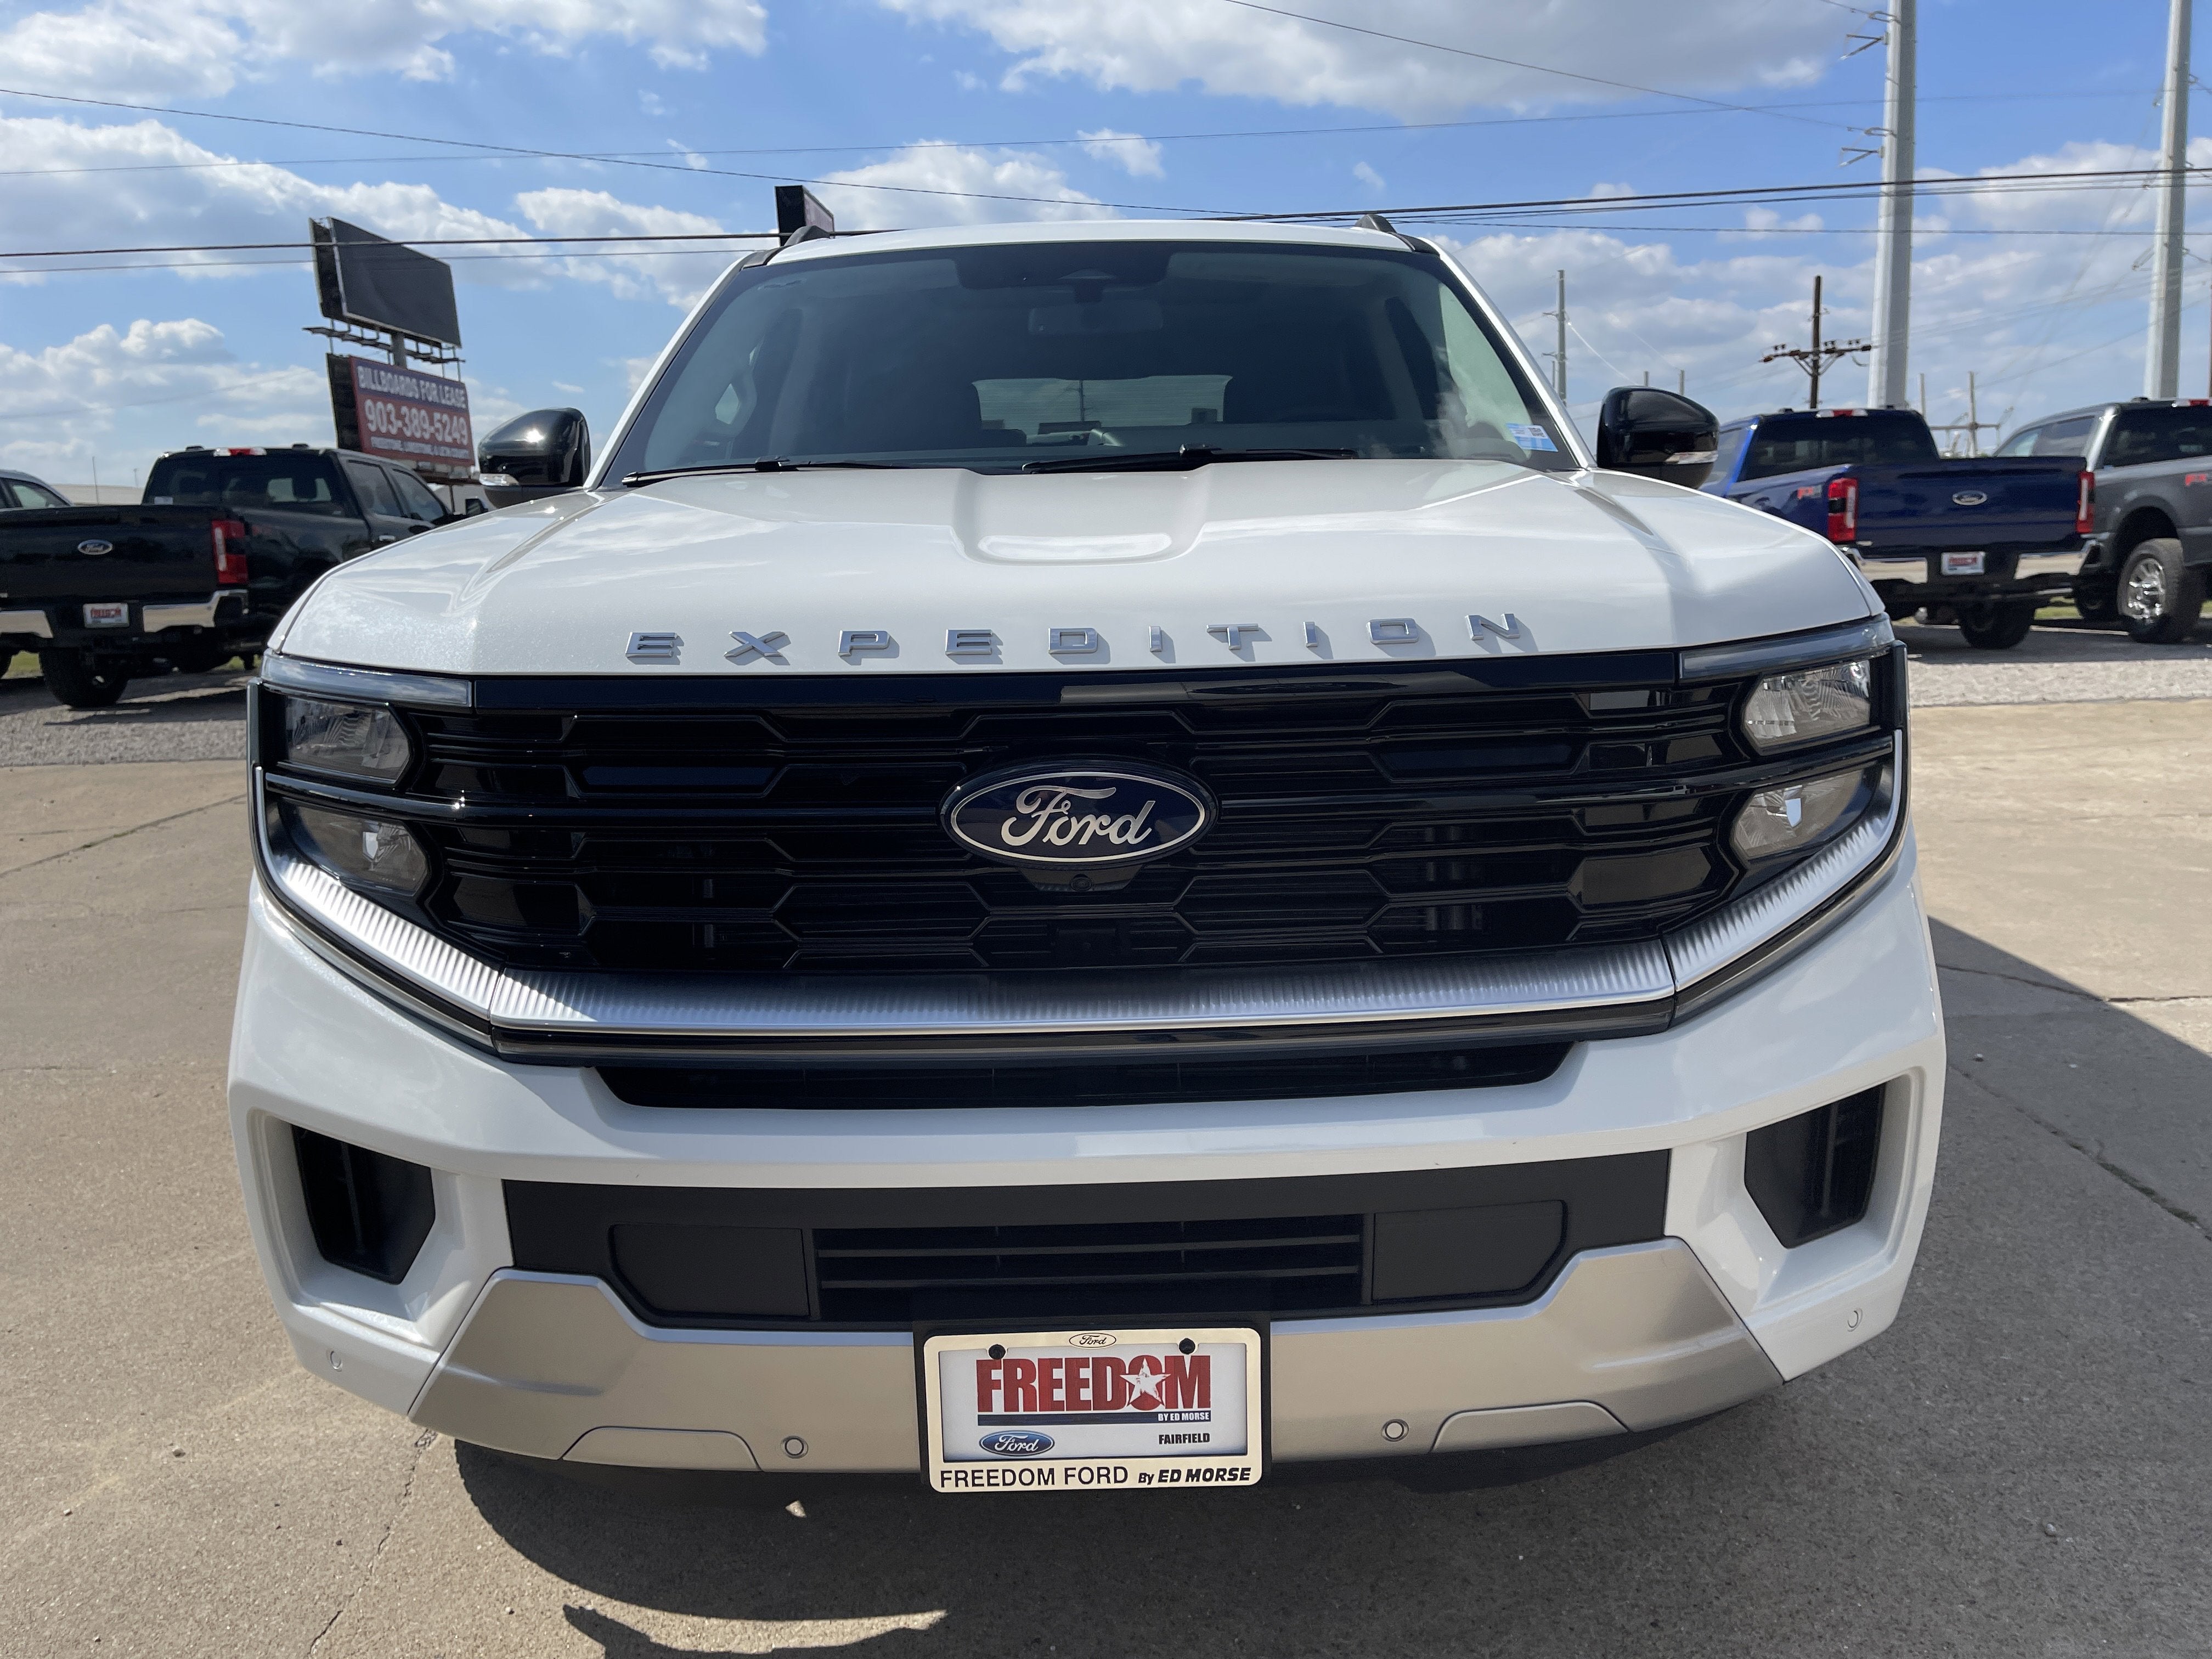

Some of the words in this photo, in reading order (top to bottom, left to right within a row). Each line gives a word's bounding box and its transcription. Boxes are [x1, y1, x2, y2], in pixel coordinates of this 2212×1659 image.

[420, 379, 438, 403] FOR
[439, 385, 466, 409] LEASE
[364, 399, 468, 445] 903-389-5249
[625, 613, 1522, 658] EXPEDITION
[1001, 785, 1156, 846] Ford
[1079, 1335, 1107, 1345] Ford
[976, 1355, 1211, 1412] FREEDOM
[1170, 1413, 1180, 1421] ED
[1182, 1412, 1209, 1421] MORSE
[994, 1434, 1040, 1451] Ford
[1159, 1433, 1210, 1444] FAIRFIELD
[940, 1468, 1055, 1488] FREEDOM
[1064, 1466, 1128, 1485] FORD
[1158, 1469, 1181, 1483] ED
[1185, 1468, 1251, 1482] MORSE
